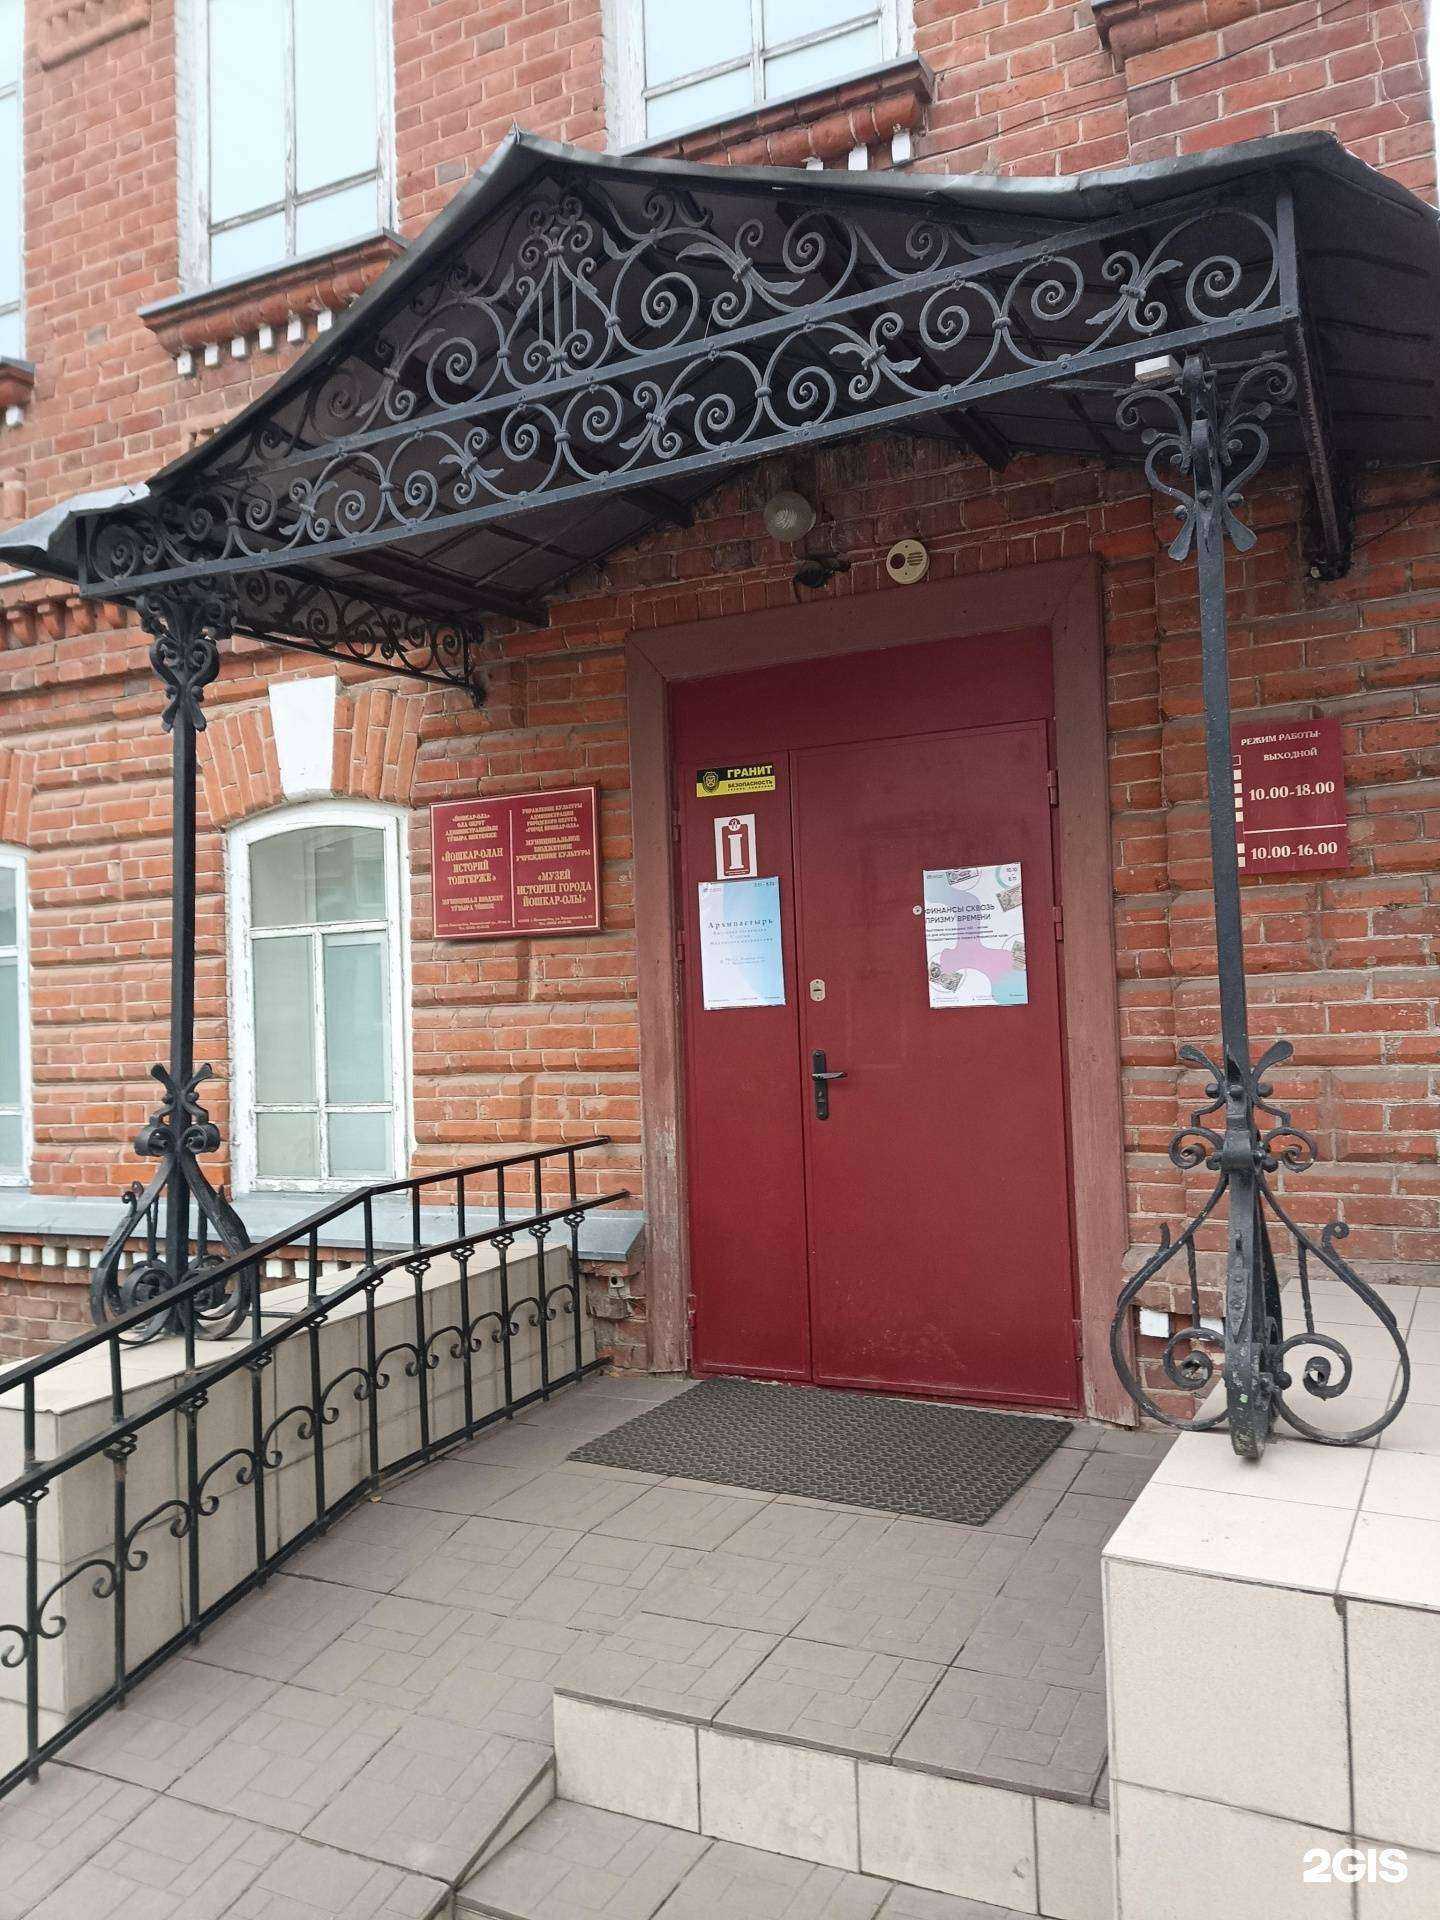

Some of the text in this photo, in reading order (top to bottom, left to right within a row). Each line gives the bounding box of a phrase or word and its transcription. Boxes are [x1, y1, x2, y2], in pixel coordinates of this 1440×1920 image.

[1241, 735, 1277, 746] РЕЖИМ
[1263, 747, 1318, 761] ВЫХОДНОЙ
[727, 765, 773, 778] ГРАНИТ
[727, 779, 773, 788] БЕЗОПАСНОСТЬ
[1249, 781, 1335, 801] 10.00-18.00
[525, 834, 581, 846] МУНИЦИПАЛЬНОЕ
[516, 849, 591, 862] УЧРЕЖДЕНИЕ КУЛЬТУРЫ
[1250, 841, 1338, 860] 10.00-16.00
[453, 859, 489, 873] ИСТОРИЙ
[537, 868, 571, 881] «МУЗЕЙ
[516, 881, 592, 895] ИСТОРИИ ГОРОДА
[523, 894, 586, 907] ЙОШКАР-ОЛЫ»
[965, 904, 995, 913] СКВОЗЬ
[957, 913, 992, 922] ВРЕМЕНИ
